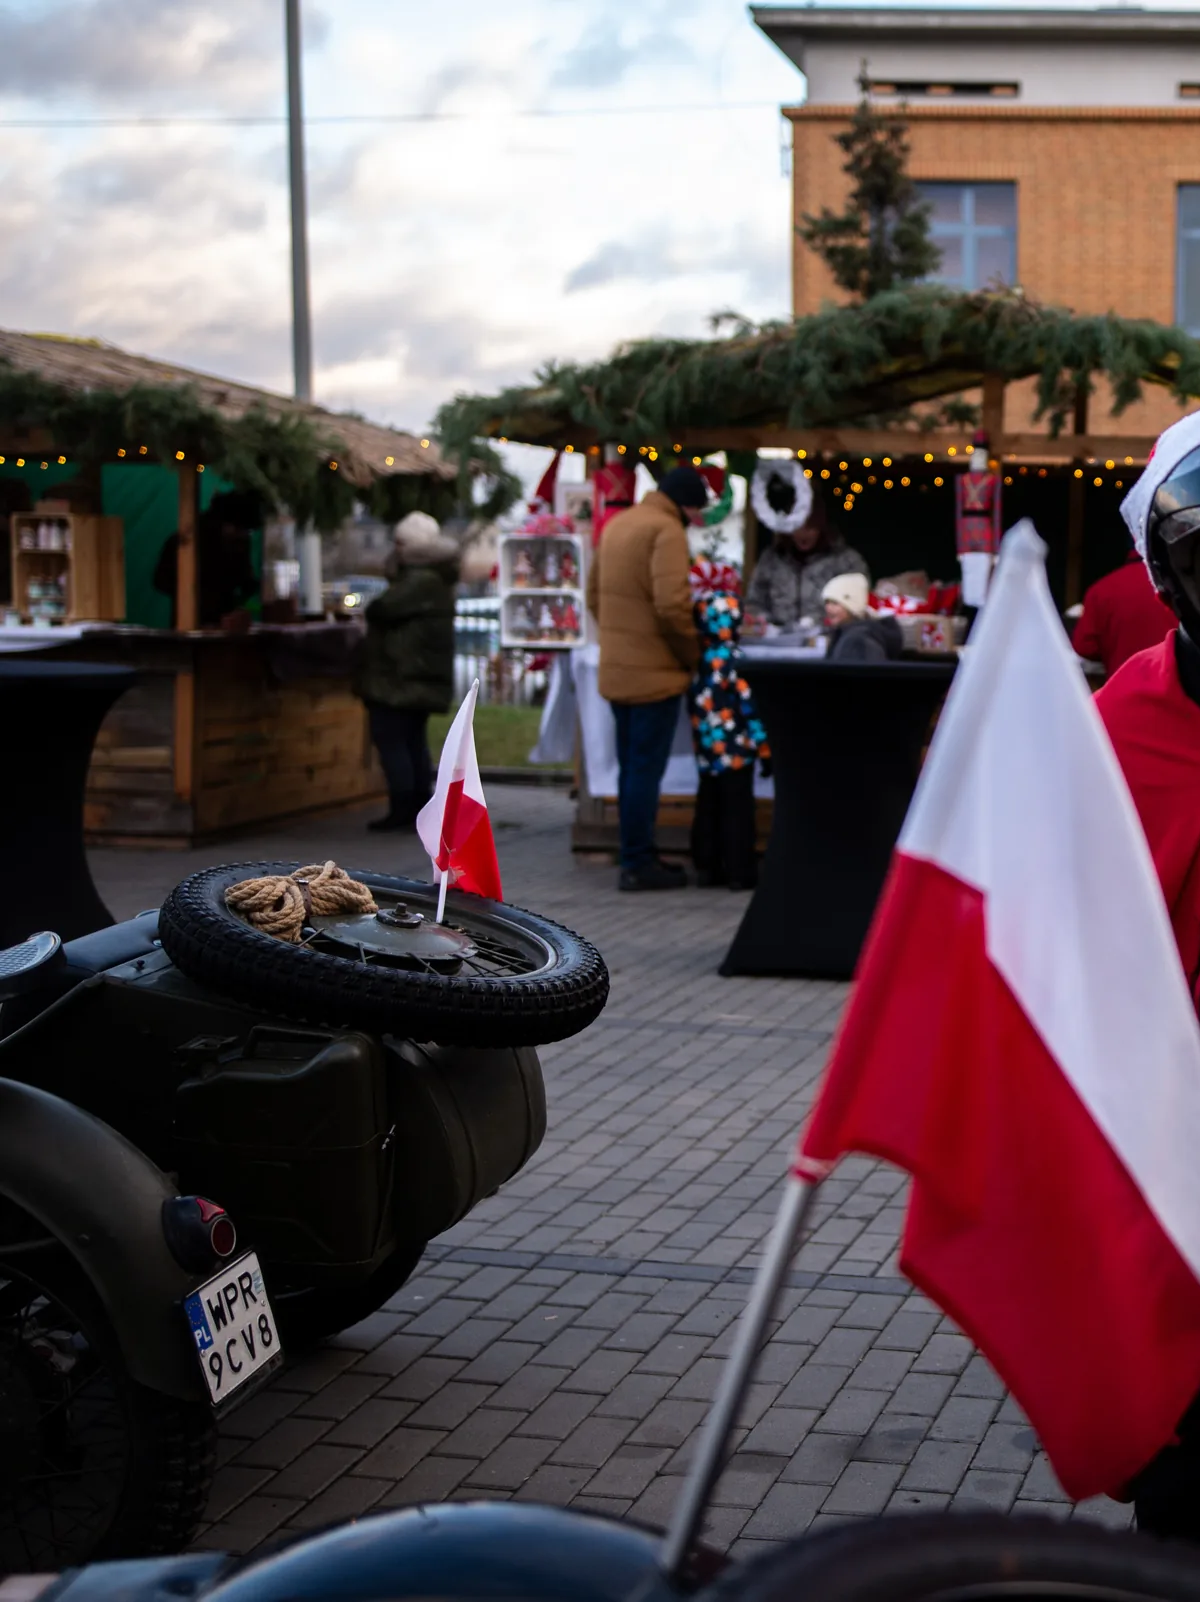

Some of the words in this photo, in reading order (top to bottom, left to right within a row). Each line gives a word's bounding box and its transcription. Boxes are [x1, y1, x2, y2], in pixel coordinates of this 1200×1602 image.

[206, 1271, 258, 1332] WPR
[194, 1328, 212, 1348] PL
[209, 1313, 273, 1391] 9CV8
